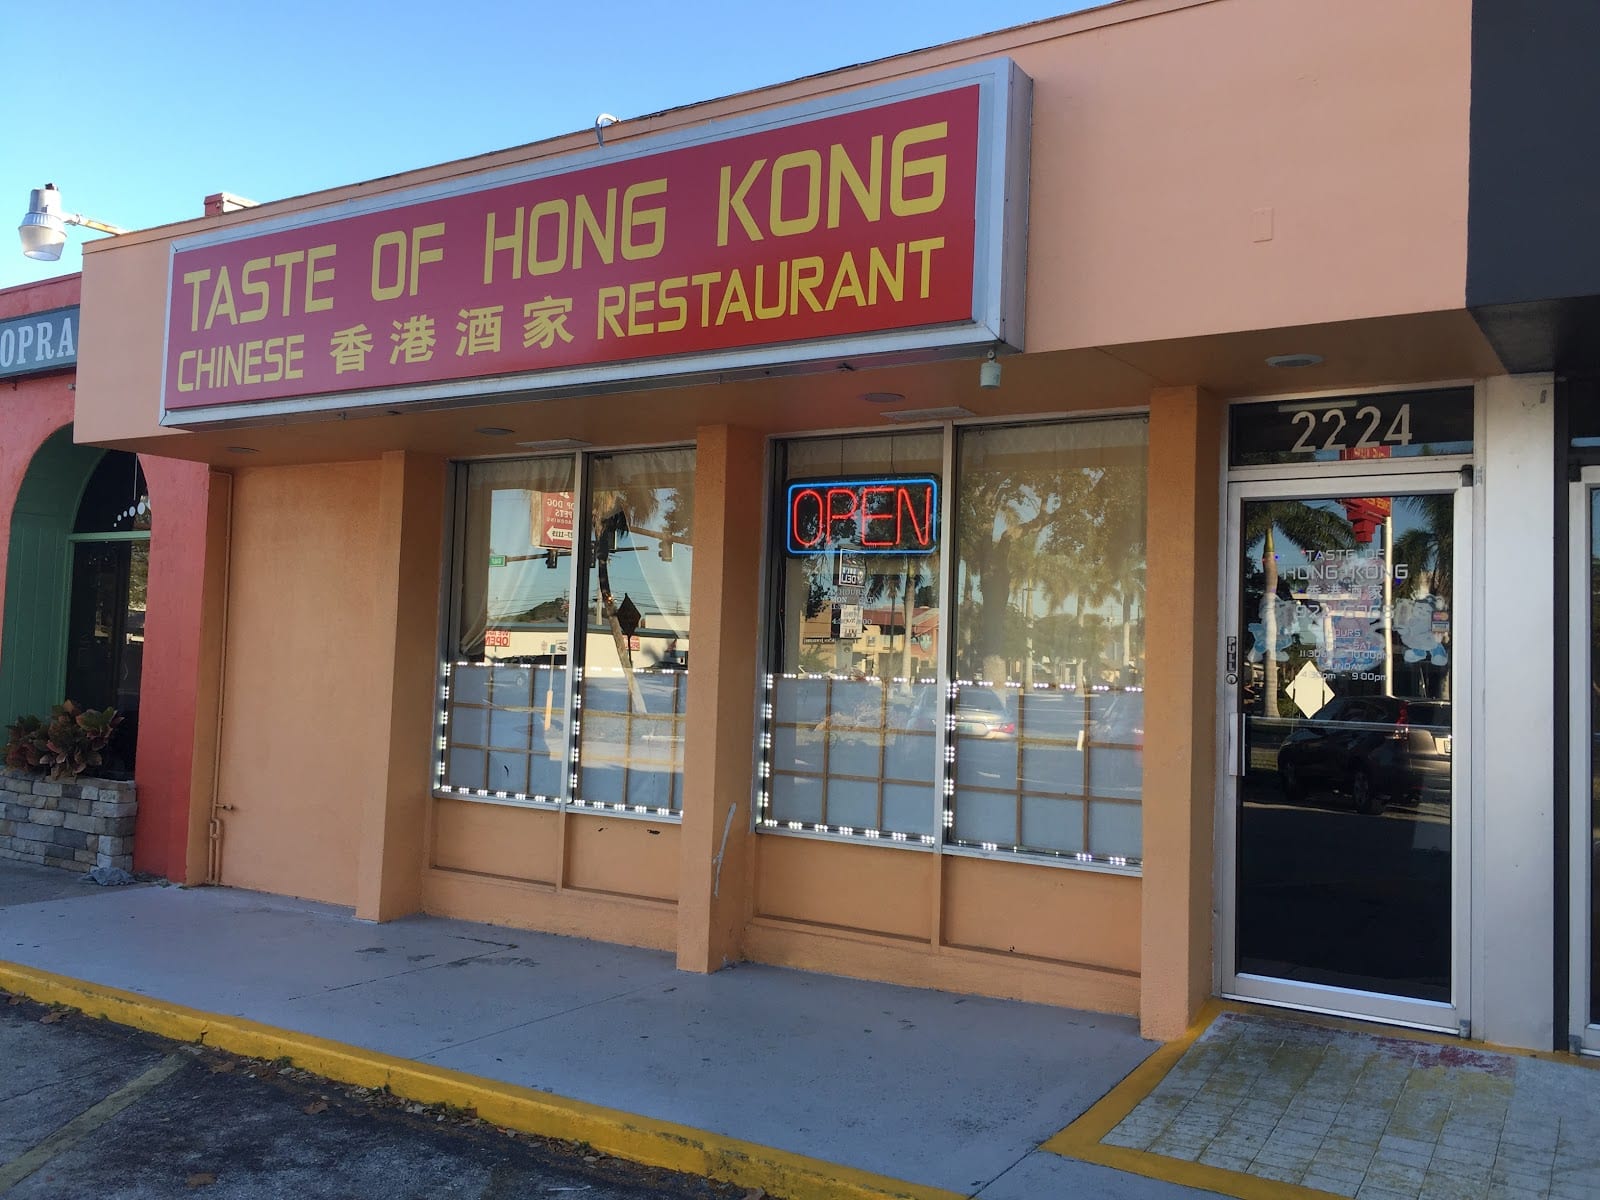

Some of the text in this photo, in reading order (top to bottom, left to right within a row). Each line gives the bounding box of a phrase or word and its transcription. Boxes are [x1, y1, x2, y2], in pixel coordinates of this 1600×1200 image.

[183, 121, 948, 333] TASTE OF HONG KONG
[597, 237, 945, 340] RESTAURANT
[329, 295, 575, 374] 香港酒家
[177, 334, 305, 392] CHINESE
[1290, 403, 1413, 454] 2224
[793, 486, 932, 546] OPEN
[1283, 563, 1409, 580] HONG KONG
[1306, 549, 1385, 561] TASTE OF
[1227, 636, 1236, 672] PULL
[1328, 628, 1361, 637] HOURS
